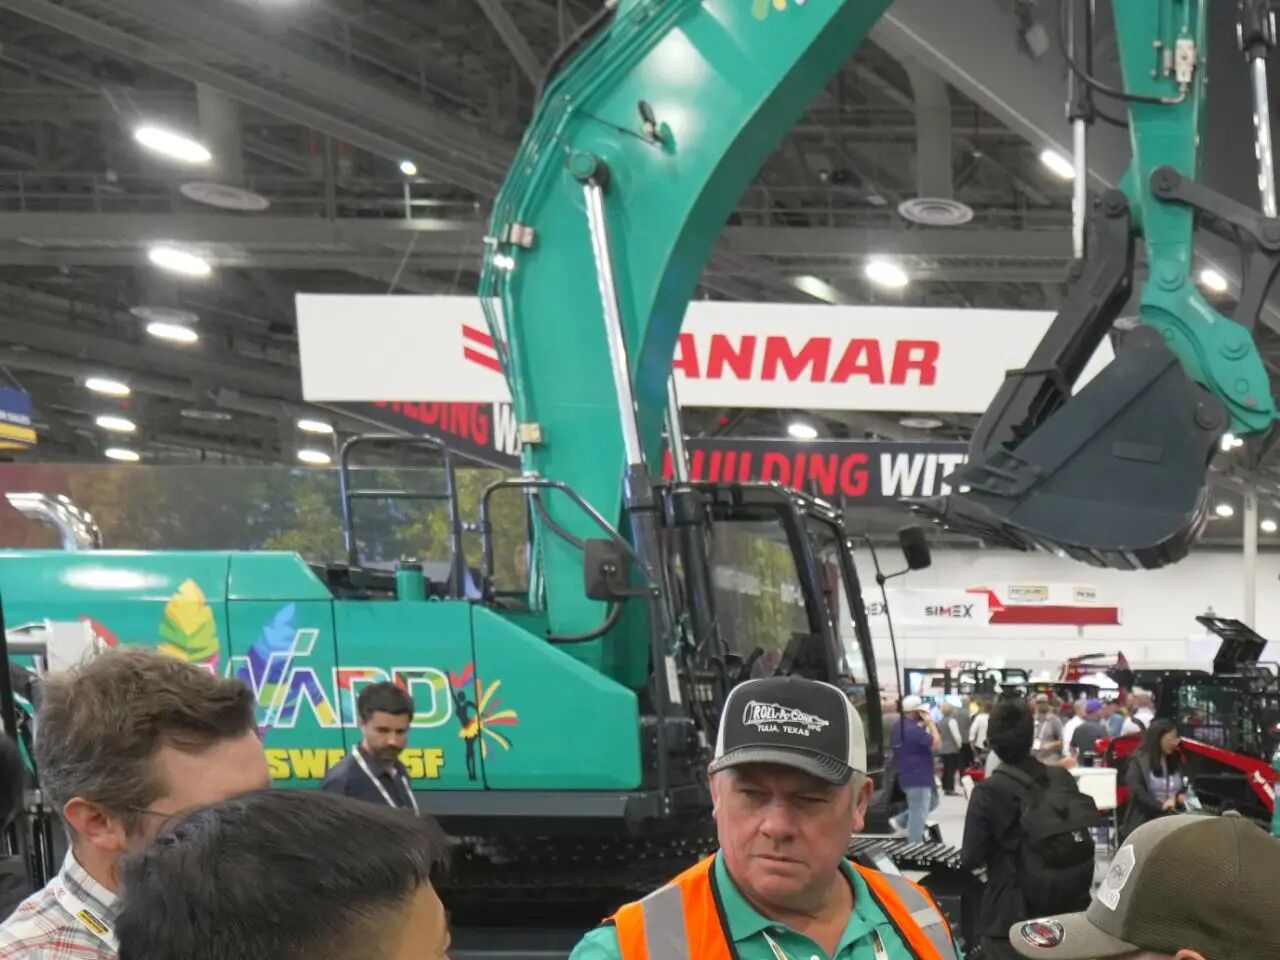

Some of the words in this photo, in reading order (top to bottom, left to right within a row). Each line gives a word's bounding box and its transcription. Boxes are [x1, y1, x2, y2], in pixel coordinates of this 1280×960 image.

[673, 333, 940, 386] ANMAR
[880, 453, 969, 497] WIT
[925, 604, 974, 618] SIMEX
